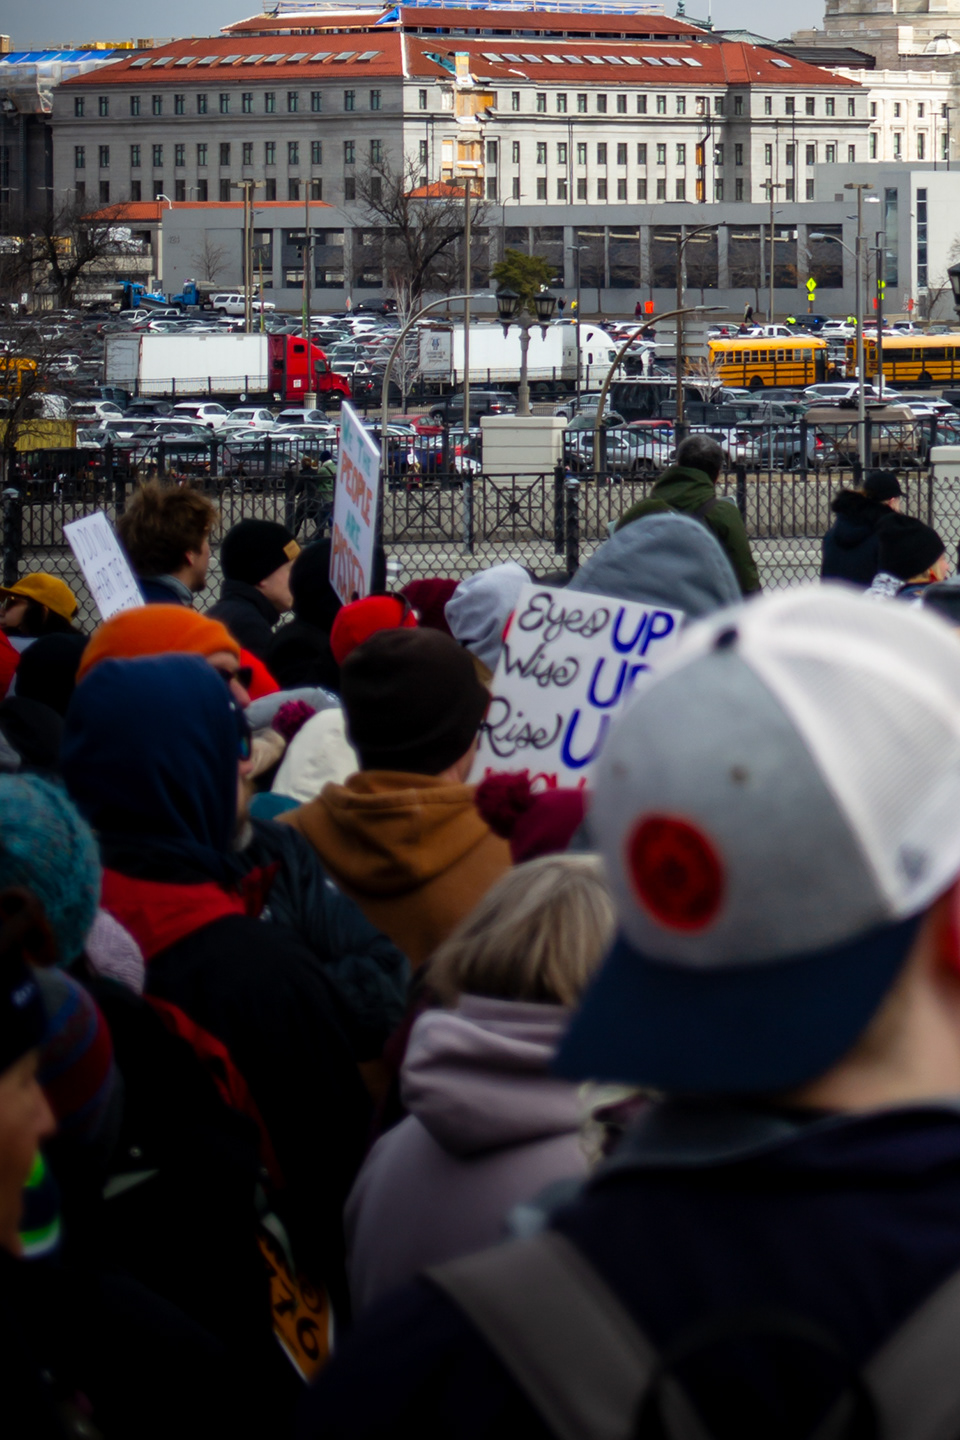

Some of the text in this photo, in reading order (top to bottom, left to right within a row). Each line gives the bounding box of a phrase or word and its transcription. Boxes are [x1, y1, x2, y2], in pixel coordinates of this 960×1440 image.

[340, 449, 373, 528] PEOPLE
[518, 592, 675, 657] Eyes UP
[503, 642, 580, 688] Wise
[477, 696, 563, 758] Rise
